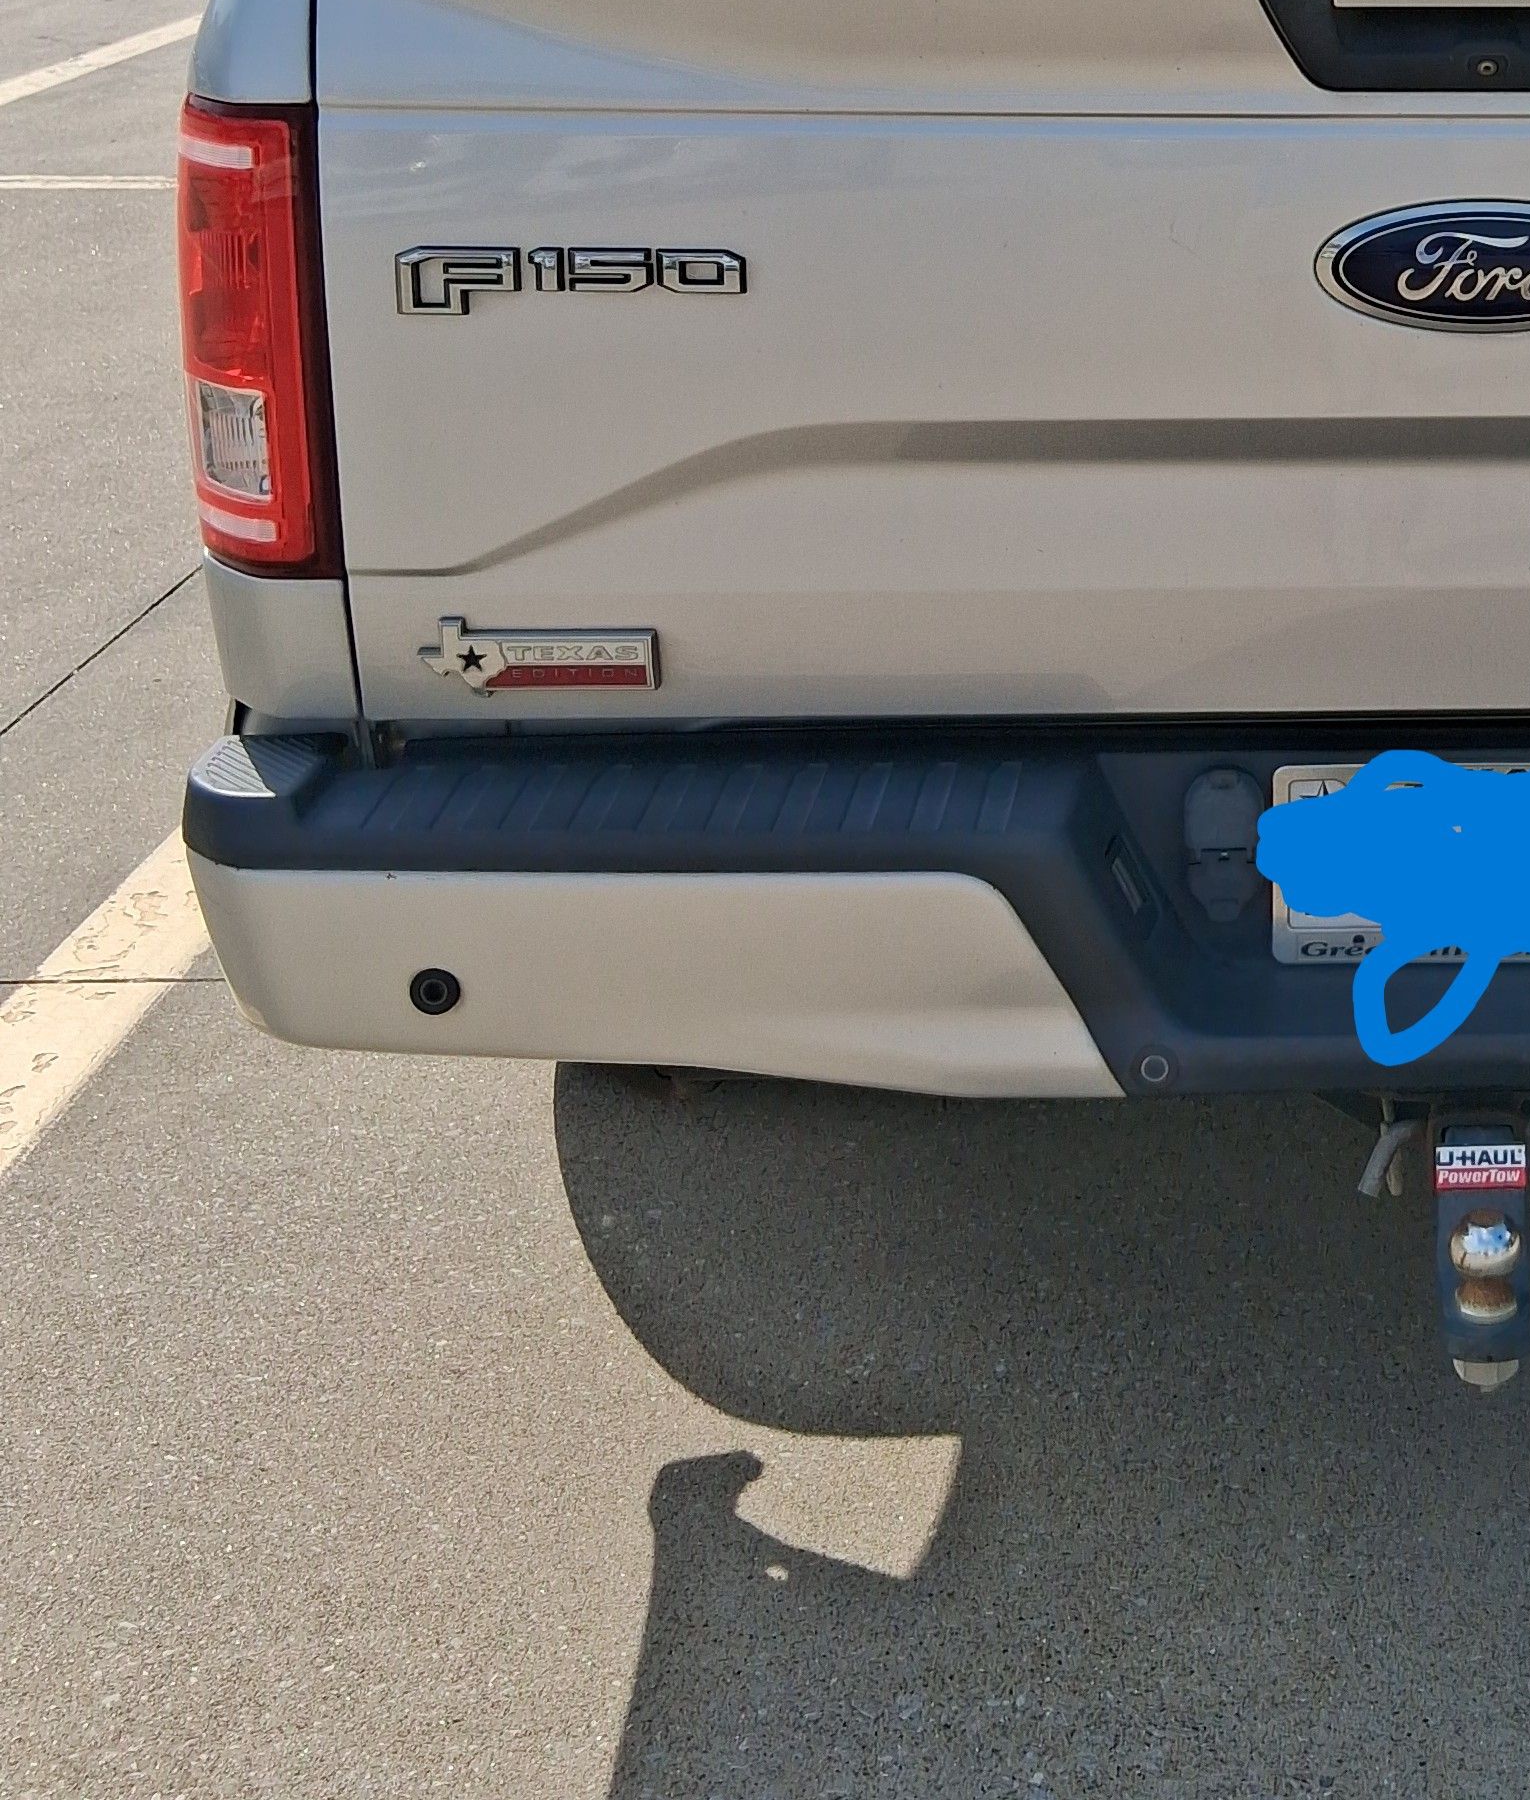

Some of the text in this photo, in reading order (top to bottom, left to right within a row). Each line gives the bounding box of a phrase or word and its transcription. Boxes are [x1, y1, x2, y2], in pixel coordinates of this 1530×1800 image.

[506, 645, 638, 662] TEXAS
[511, 668, 639, 679] EDITION
[1437, 1149, 1523, 1167] U-HAUL
[1438, 1168, 1520, 1185] PowerTow
